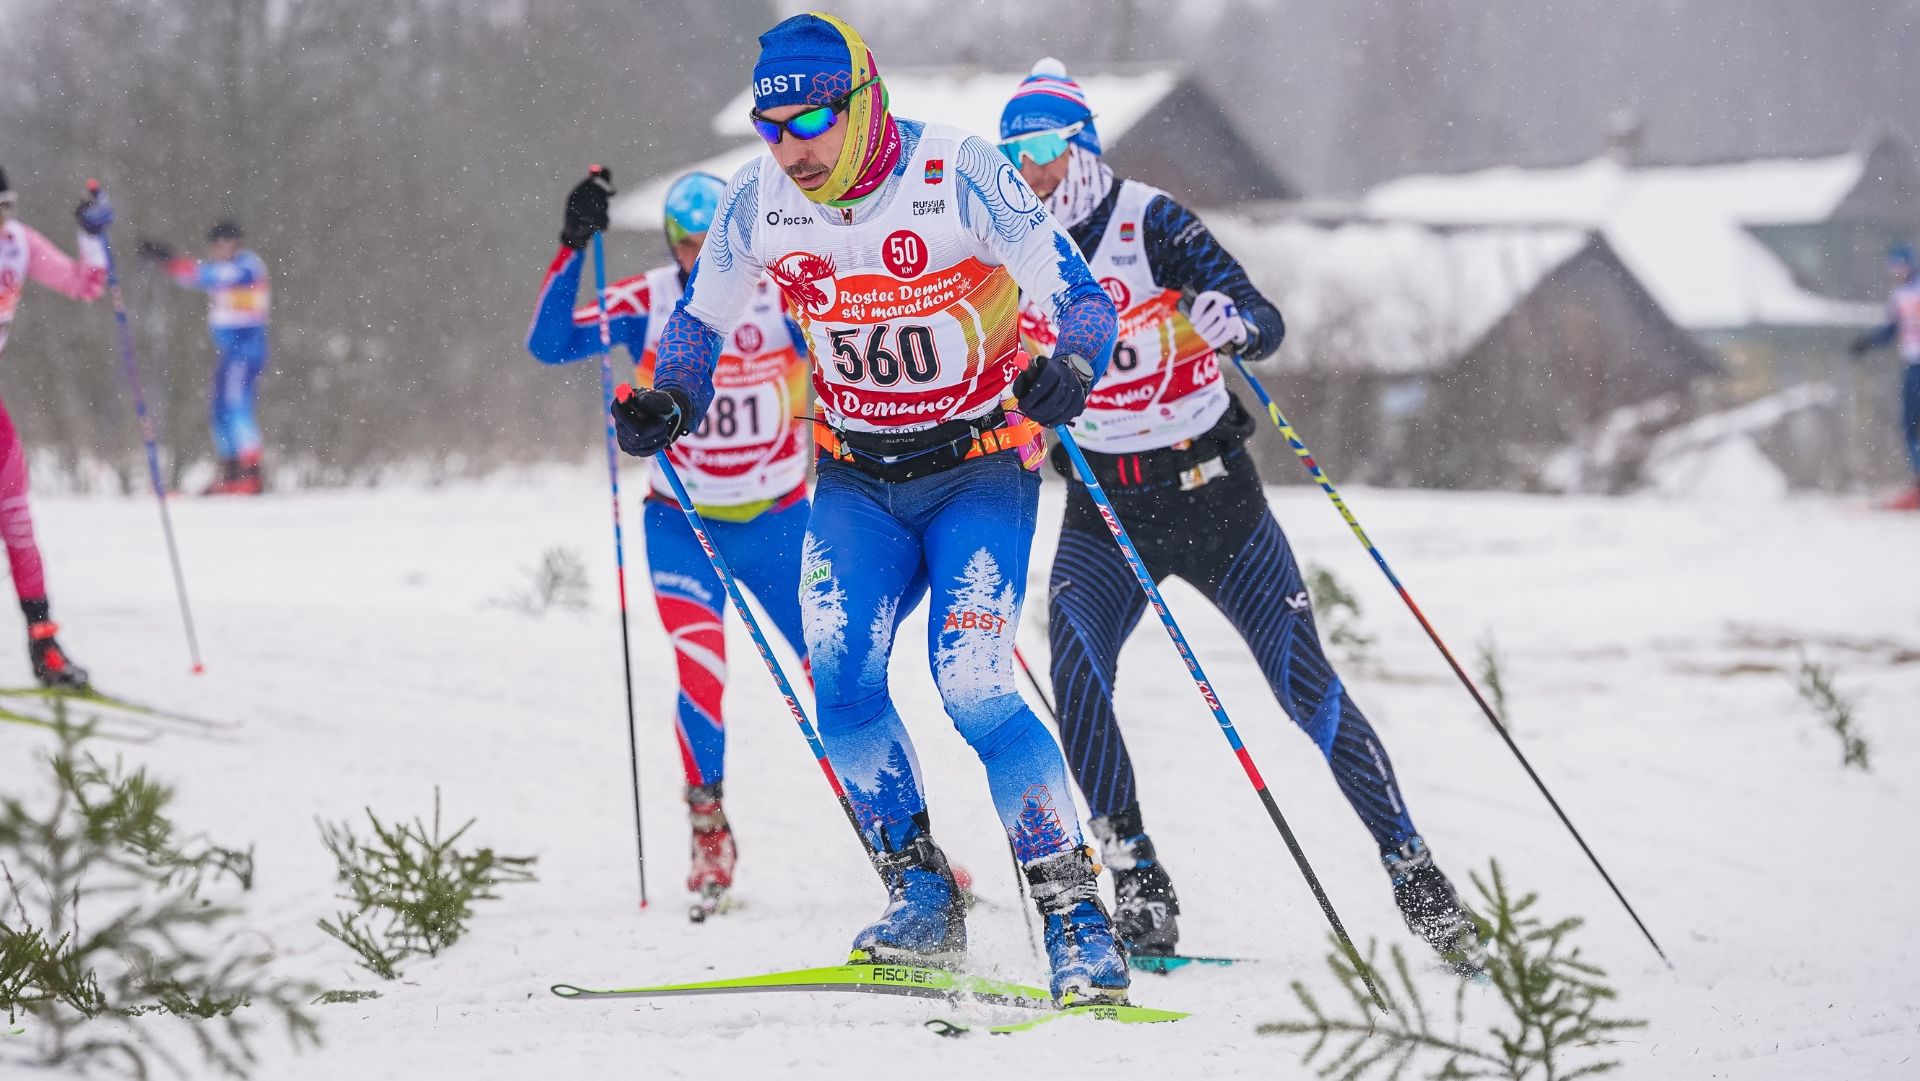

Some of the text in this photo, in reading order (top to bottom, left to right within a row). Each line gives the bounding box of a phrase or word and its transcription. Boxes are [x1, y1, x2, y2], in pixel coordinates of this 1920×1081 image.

[754, 74, 806, 100] ABST
[912, 199, 945, 209] RUSSIA
[913, 206, 946, 216] LOPPET
[890, 236, 918, 266] 50
[840, 271, 962, 305] Rostec Demino
[841, 289, 955, 321] ski marathon
[826, 324, 941, 388] 560
[944, 612, 1007, 635] ABST
[873, 967, 933, 985] FISCHER
